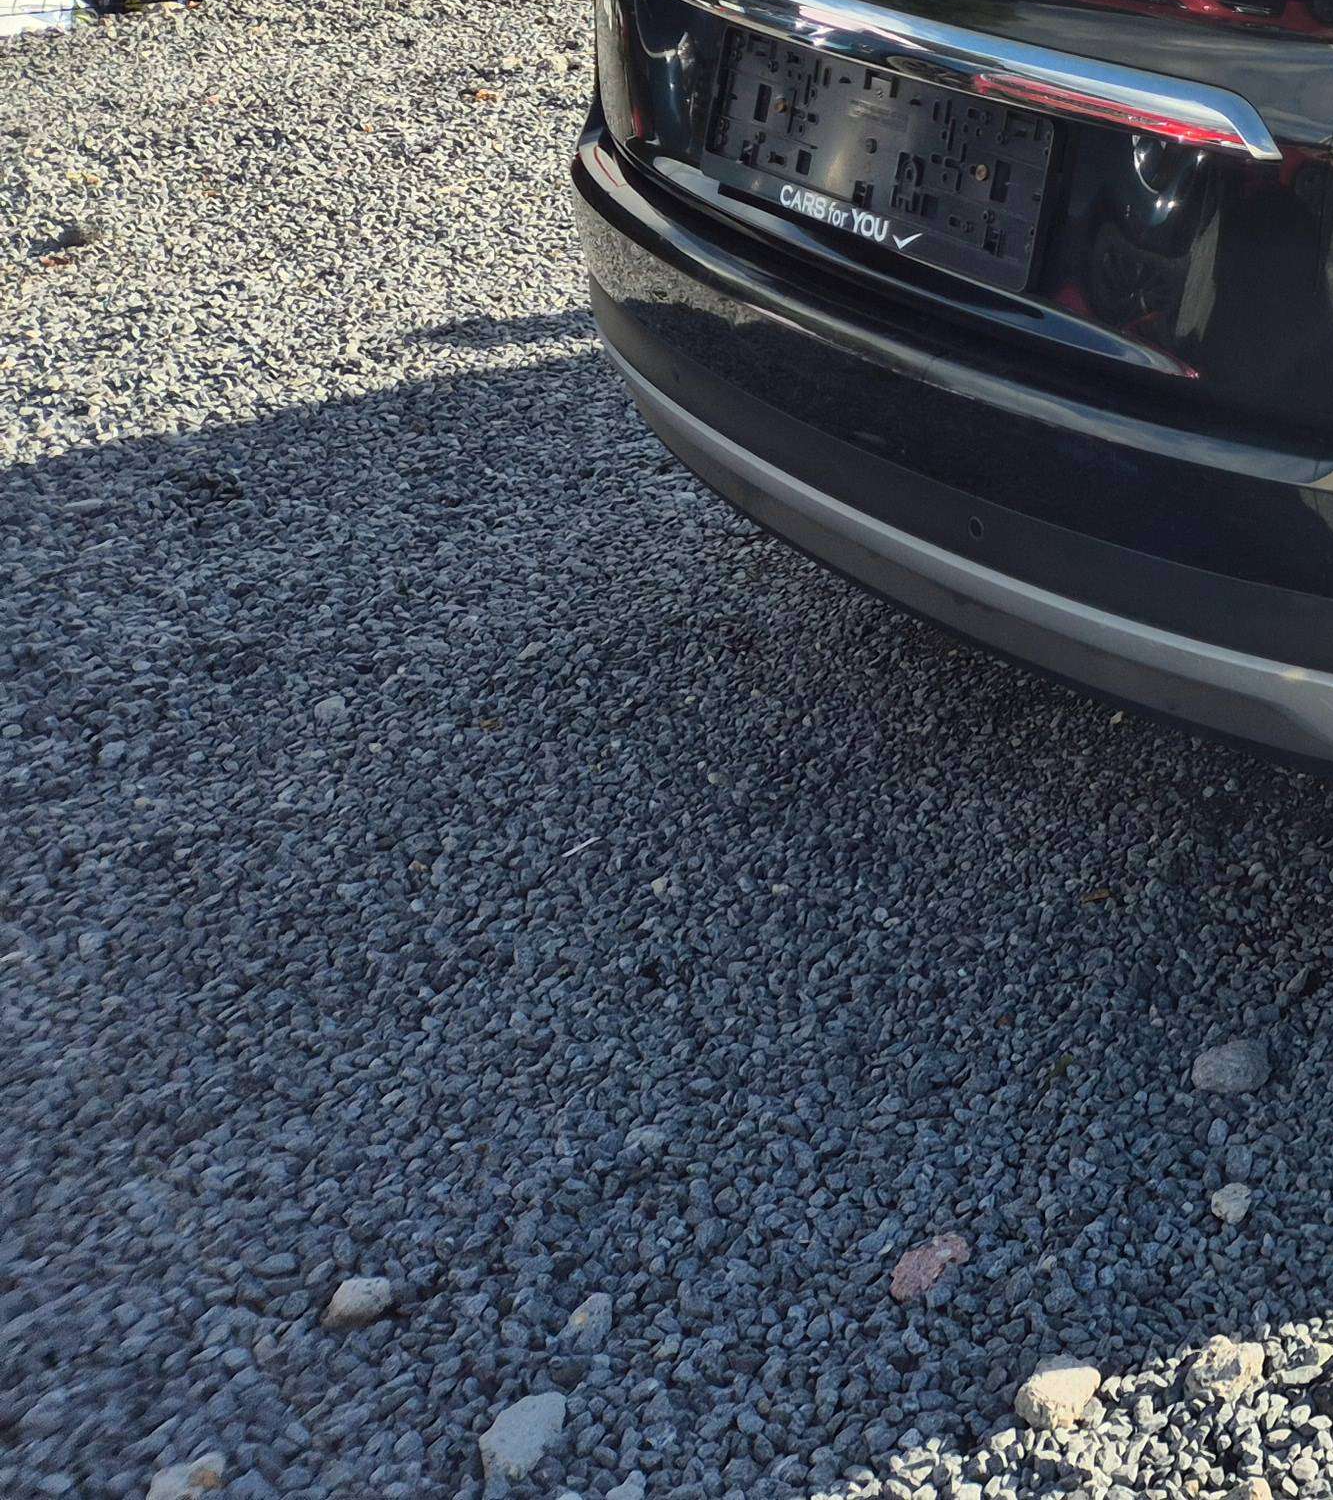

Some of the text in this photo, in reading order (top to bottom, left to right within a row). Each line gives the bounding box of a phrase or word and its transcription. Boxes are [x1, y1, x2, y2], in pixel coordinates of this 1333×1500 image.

[780, 185, 890, 242] CARS for YOU
